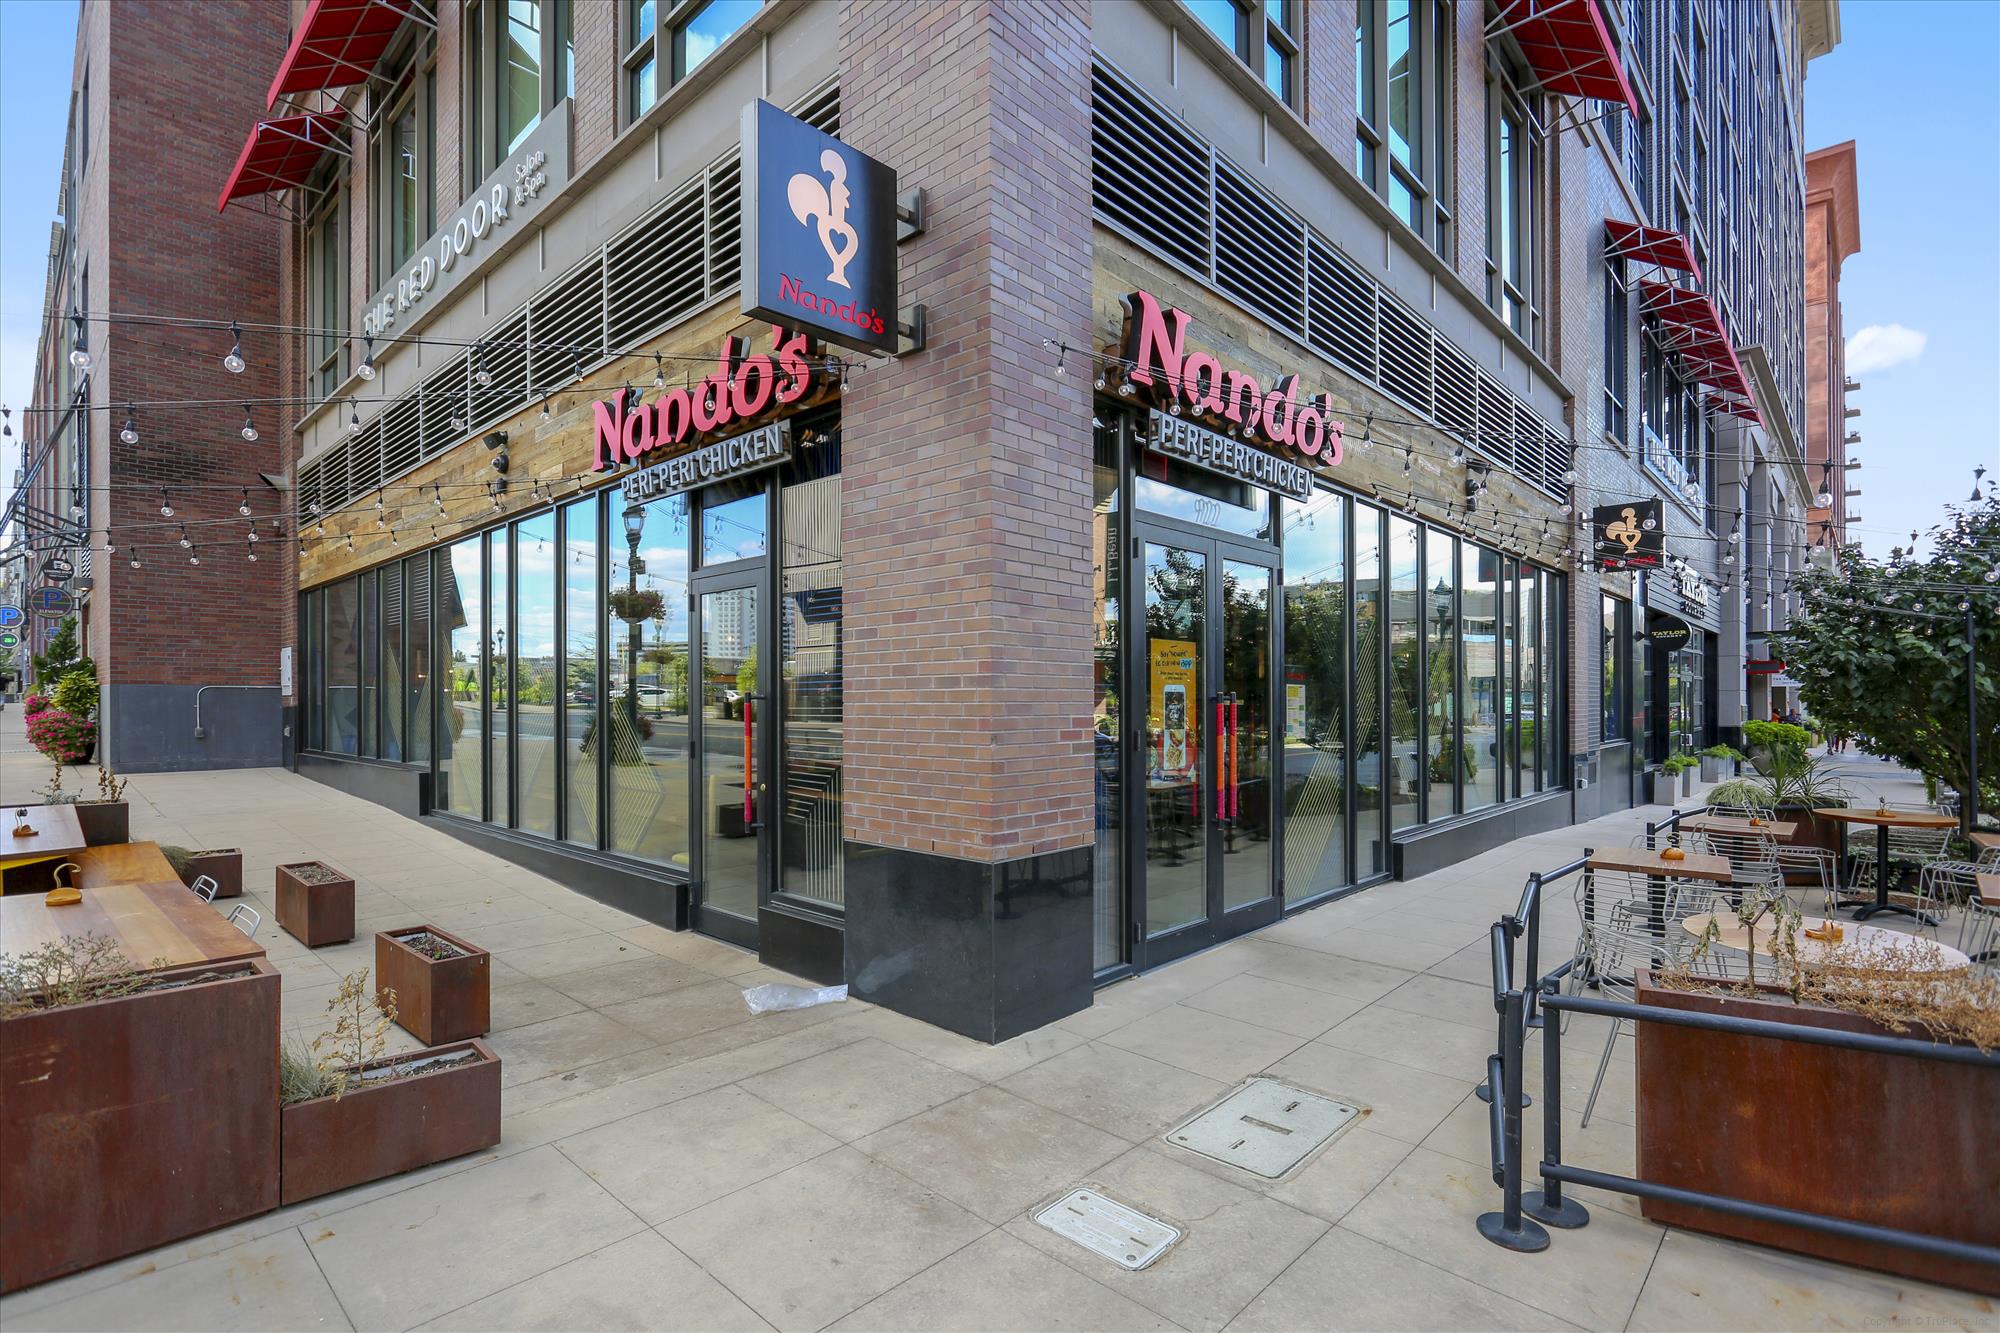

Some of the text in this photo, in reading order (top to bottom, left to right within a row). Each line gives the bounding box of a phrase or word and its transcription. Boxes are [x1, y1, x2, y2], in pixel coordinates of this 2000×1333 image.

[524, 171, 546, 198] Spa
[363, 184, 509, 337] THE RED DOOR
[777, 272, 886, 335] Nando's
[591, 325, 810, 472] Nando's
[1131, 290, 1345, 467] Nando's
[621, 425, 784, 499] PERI-PERI CHICKEN
[1161, 415, 1314, 497] PERI-PERI CHICKEN
[0, 607, 18, 625] P
[43, 590, 62, 608] P
